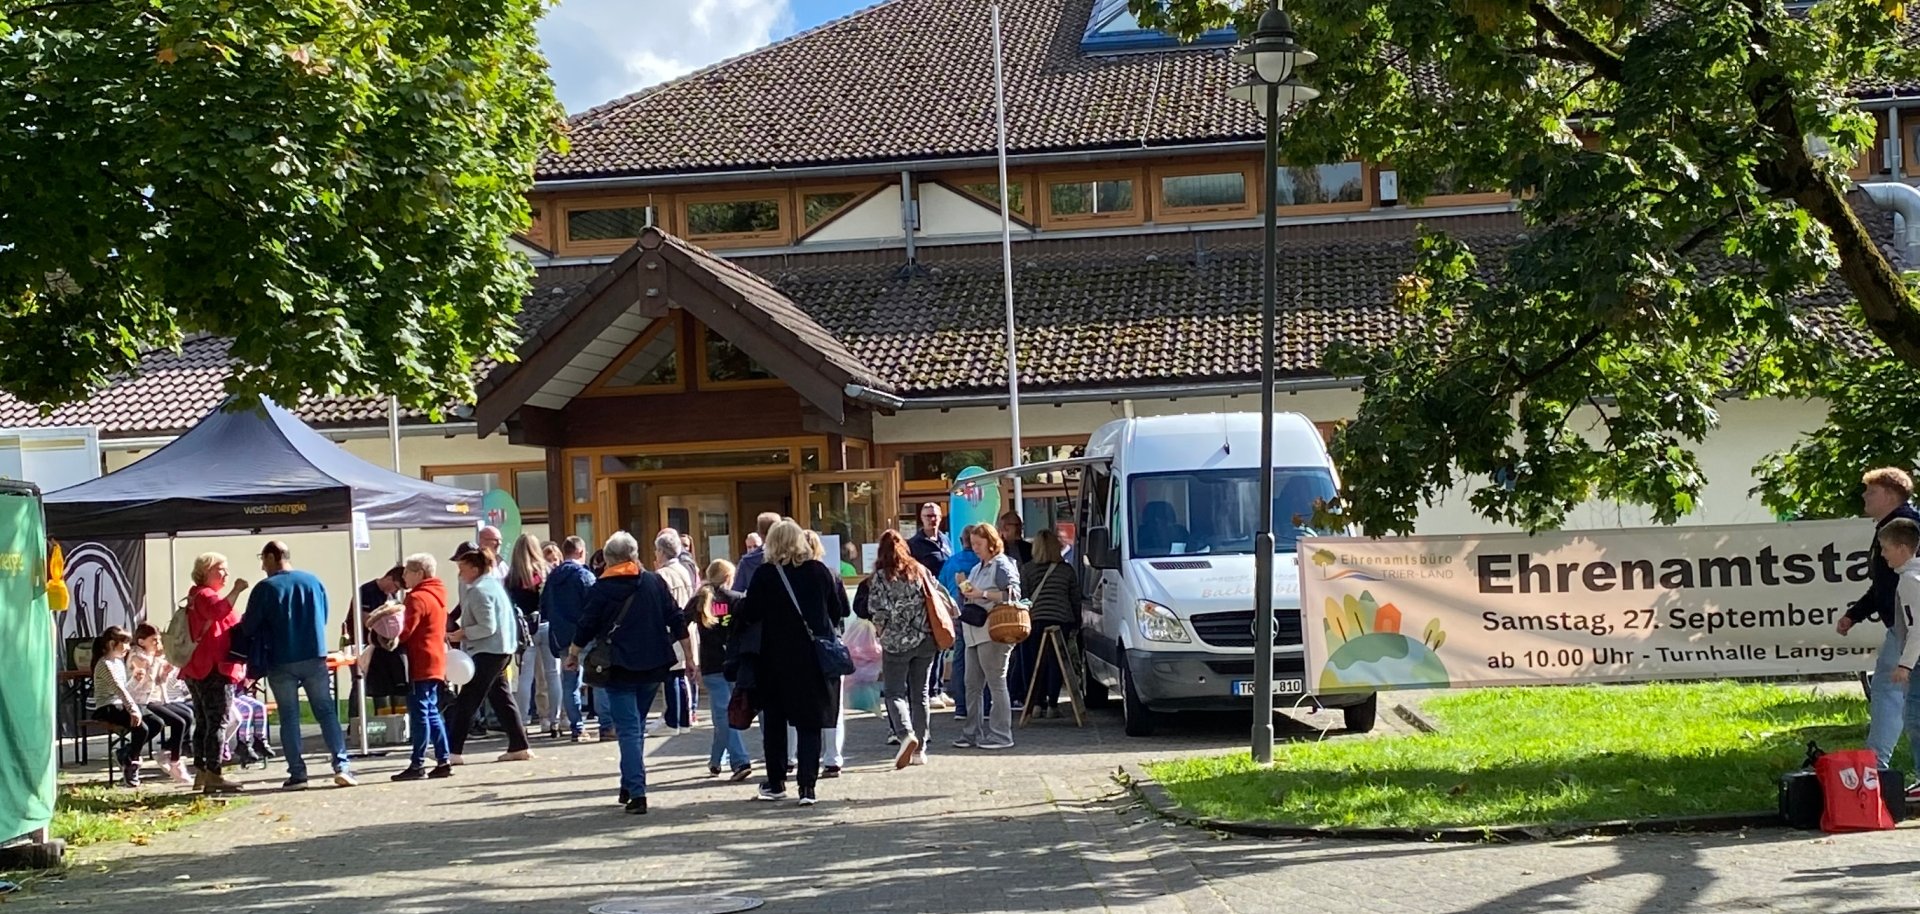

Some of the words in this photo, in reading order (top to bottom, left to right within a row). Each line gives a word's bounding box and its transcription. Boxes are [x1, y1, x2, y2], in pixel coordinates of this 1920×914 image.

[243, 501, 307, 515] westenergie
[1341, 553, 1453, 566] Ehrenamtsbüro
[1381, 569, 1454, 580] TRIER-LAND
[1477, 542, 1873, 594] Ehrenamtsta
[1482, 611, 1615, 636] Samstag,
[1623, 608, 1660, 630] 27.
[1669, 603, 1838, 634] September
[1487, 651, 1515, 669] ab
[1523, 649, 1584, 668] 10.00
[1592, 647, 1634, 665] Uhr
[1655, 644, 1767, 664] Turnhalle
[1775, 644, 1876, 662] Langsur
[1279, 681, 1301, 692] 810
